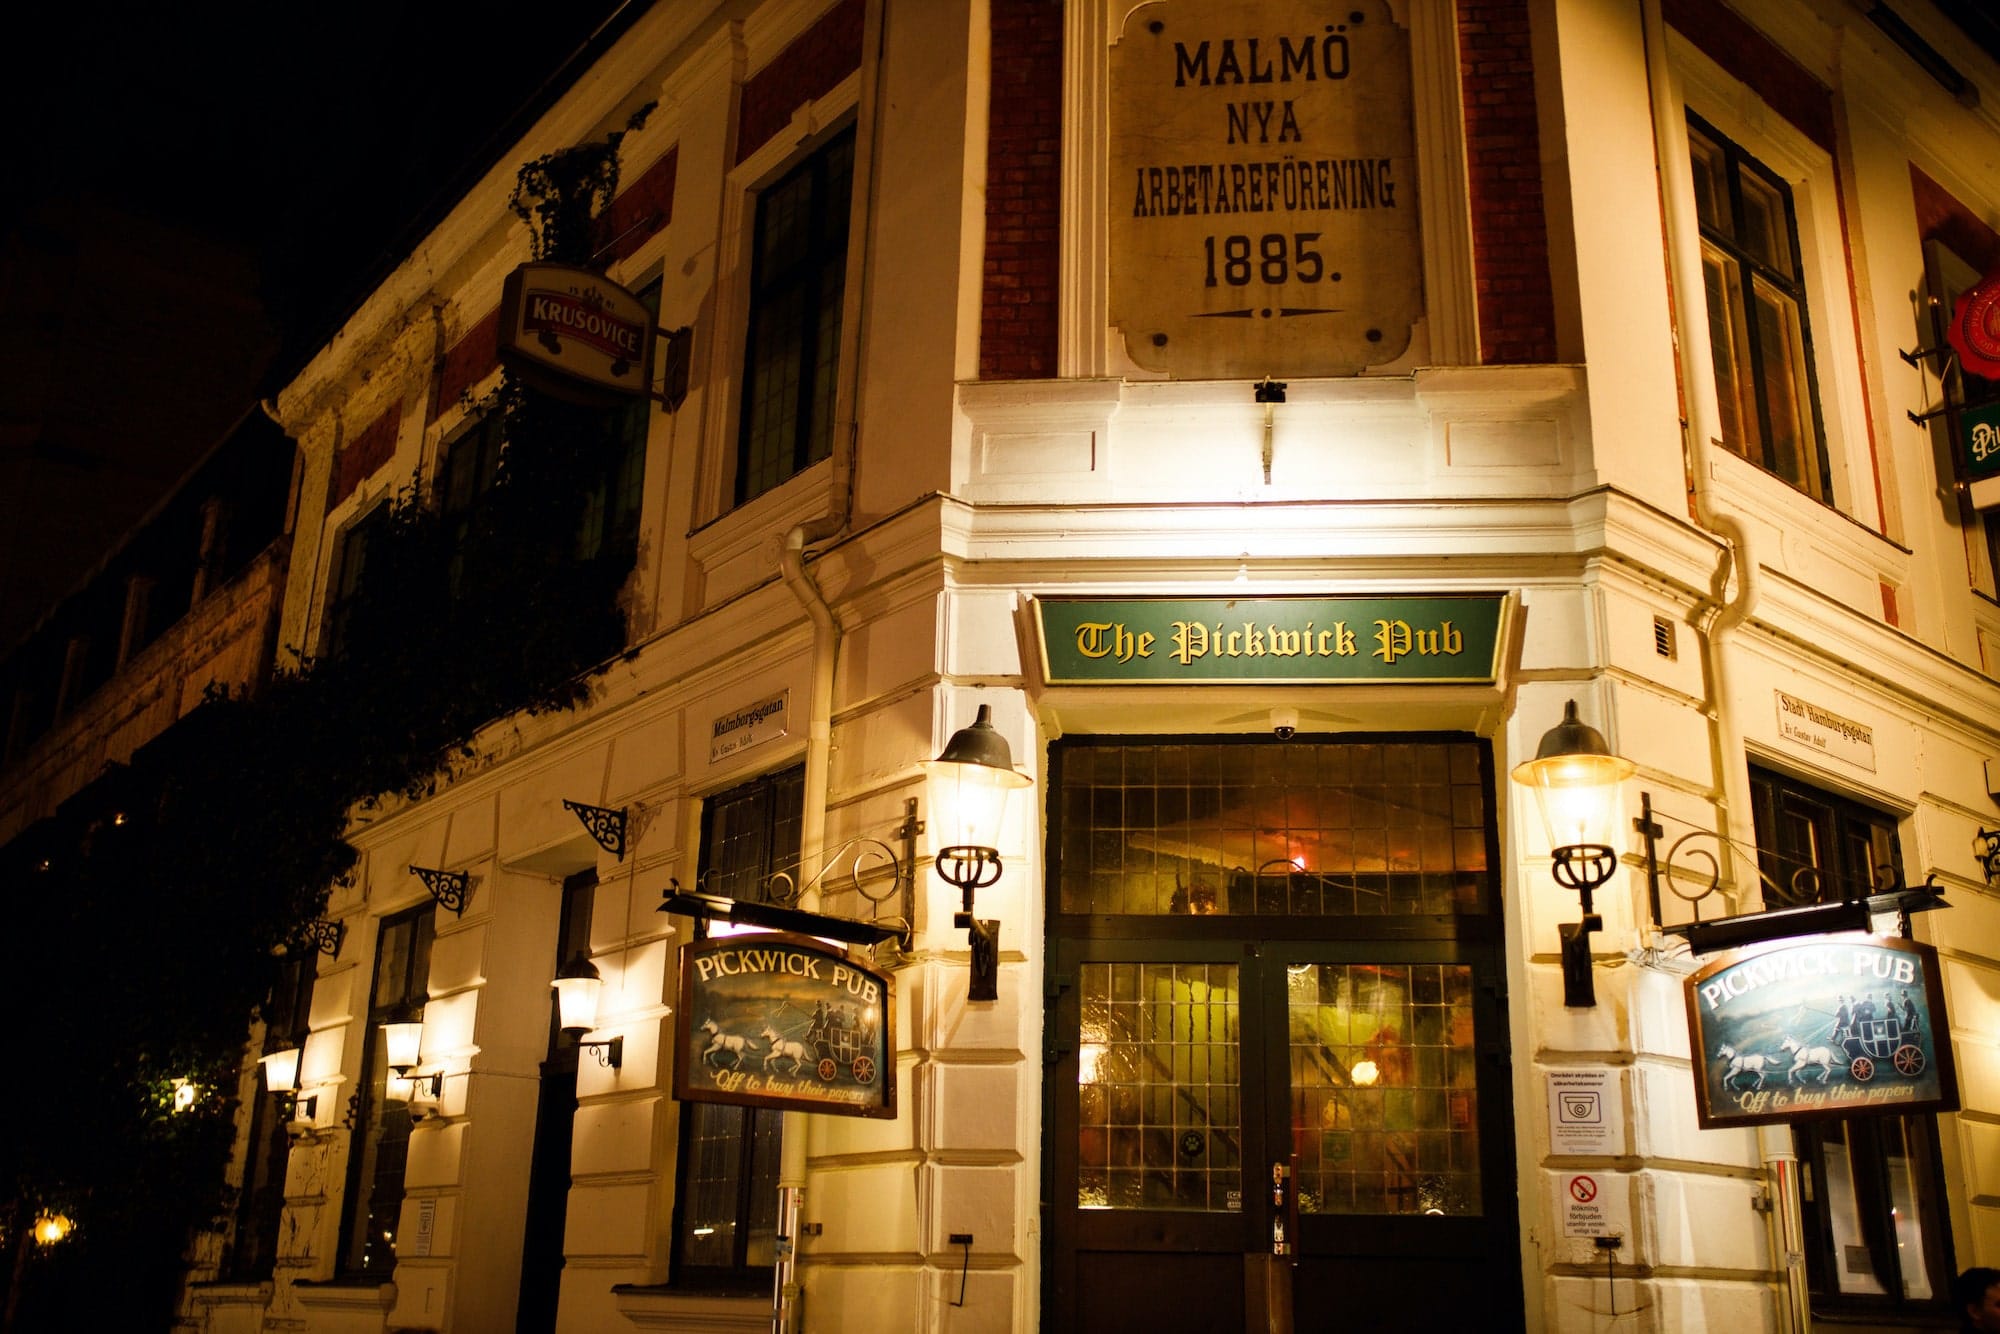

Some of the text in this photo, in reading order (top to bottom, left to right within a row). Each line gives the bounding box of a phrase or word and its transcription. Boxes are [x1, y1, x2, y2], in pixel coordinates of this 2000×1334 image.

[1174, 25, 1350, 87] MALMÖ
[1227, 100, 1302, 144] NYA
[1133, 155, 1396, 217] ARBETAREFÖRENING
[1204, 232, 1342, 288] 1885.
[1074, 619, 1464, 665] The Pickwick Pub
[712, 699, 783, 737] Malmborgsgatan
[1806, 704, 1873, 746] Hamburgsgatan
[695, 949, 879, 1005] PICKWICK PUB
[1701, 950, 1915, 1010] PICKWICK PUB
[710, 1069, 746, 1092] Off
[746, 1075, 761, 1090] to
[766, 1075, 794, 1097] buy
[797, 1080, 827, 1097] their
[1733, 1083, 1914, 1113] Off to buy their papers
